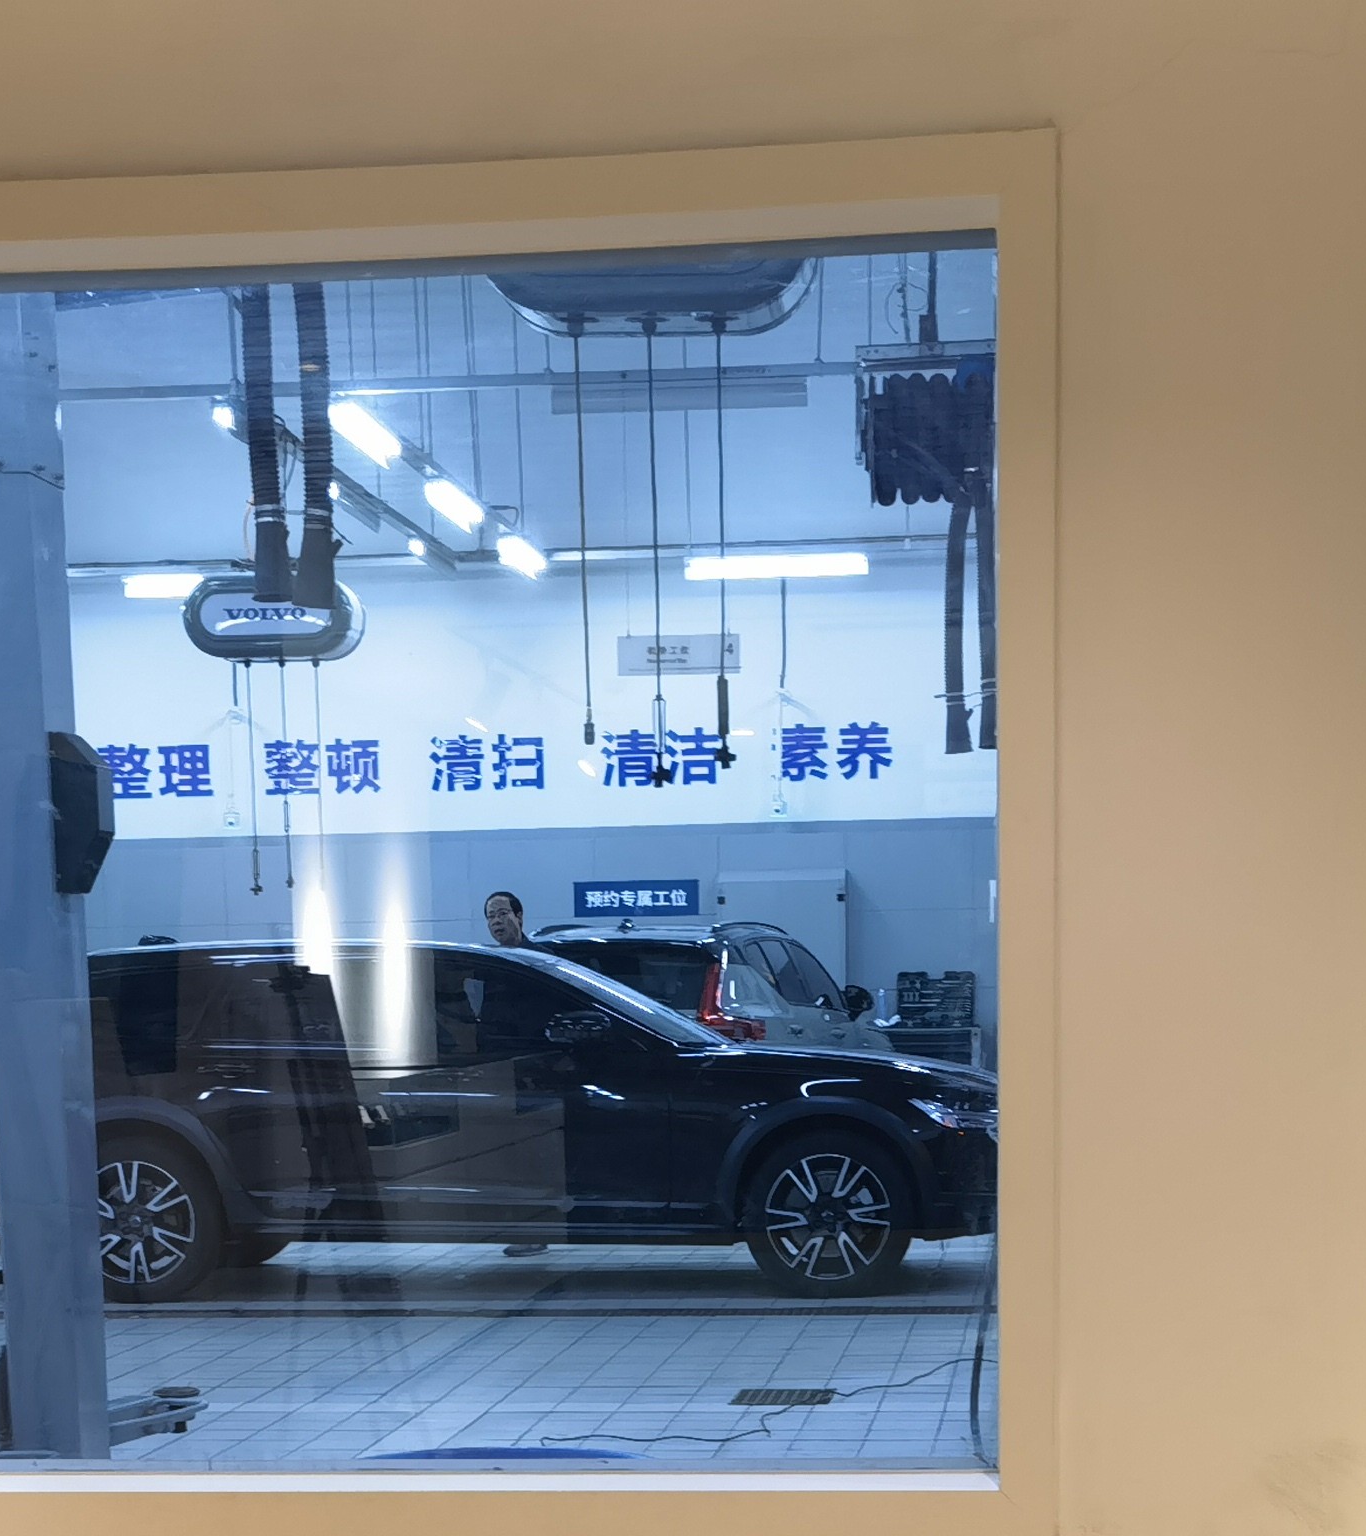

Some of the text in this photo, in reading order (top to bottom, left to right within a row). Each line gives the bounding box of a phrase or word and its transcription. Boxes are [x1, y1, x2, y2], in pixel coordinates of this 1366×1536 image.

[223, 607, 306, 620] VOLVO
[97, 721, 893, 799] 整理 整顿 清扫 清洁 素养
[585, 889, 688, 908] 预约专属工位
